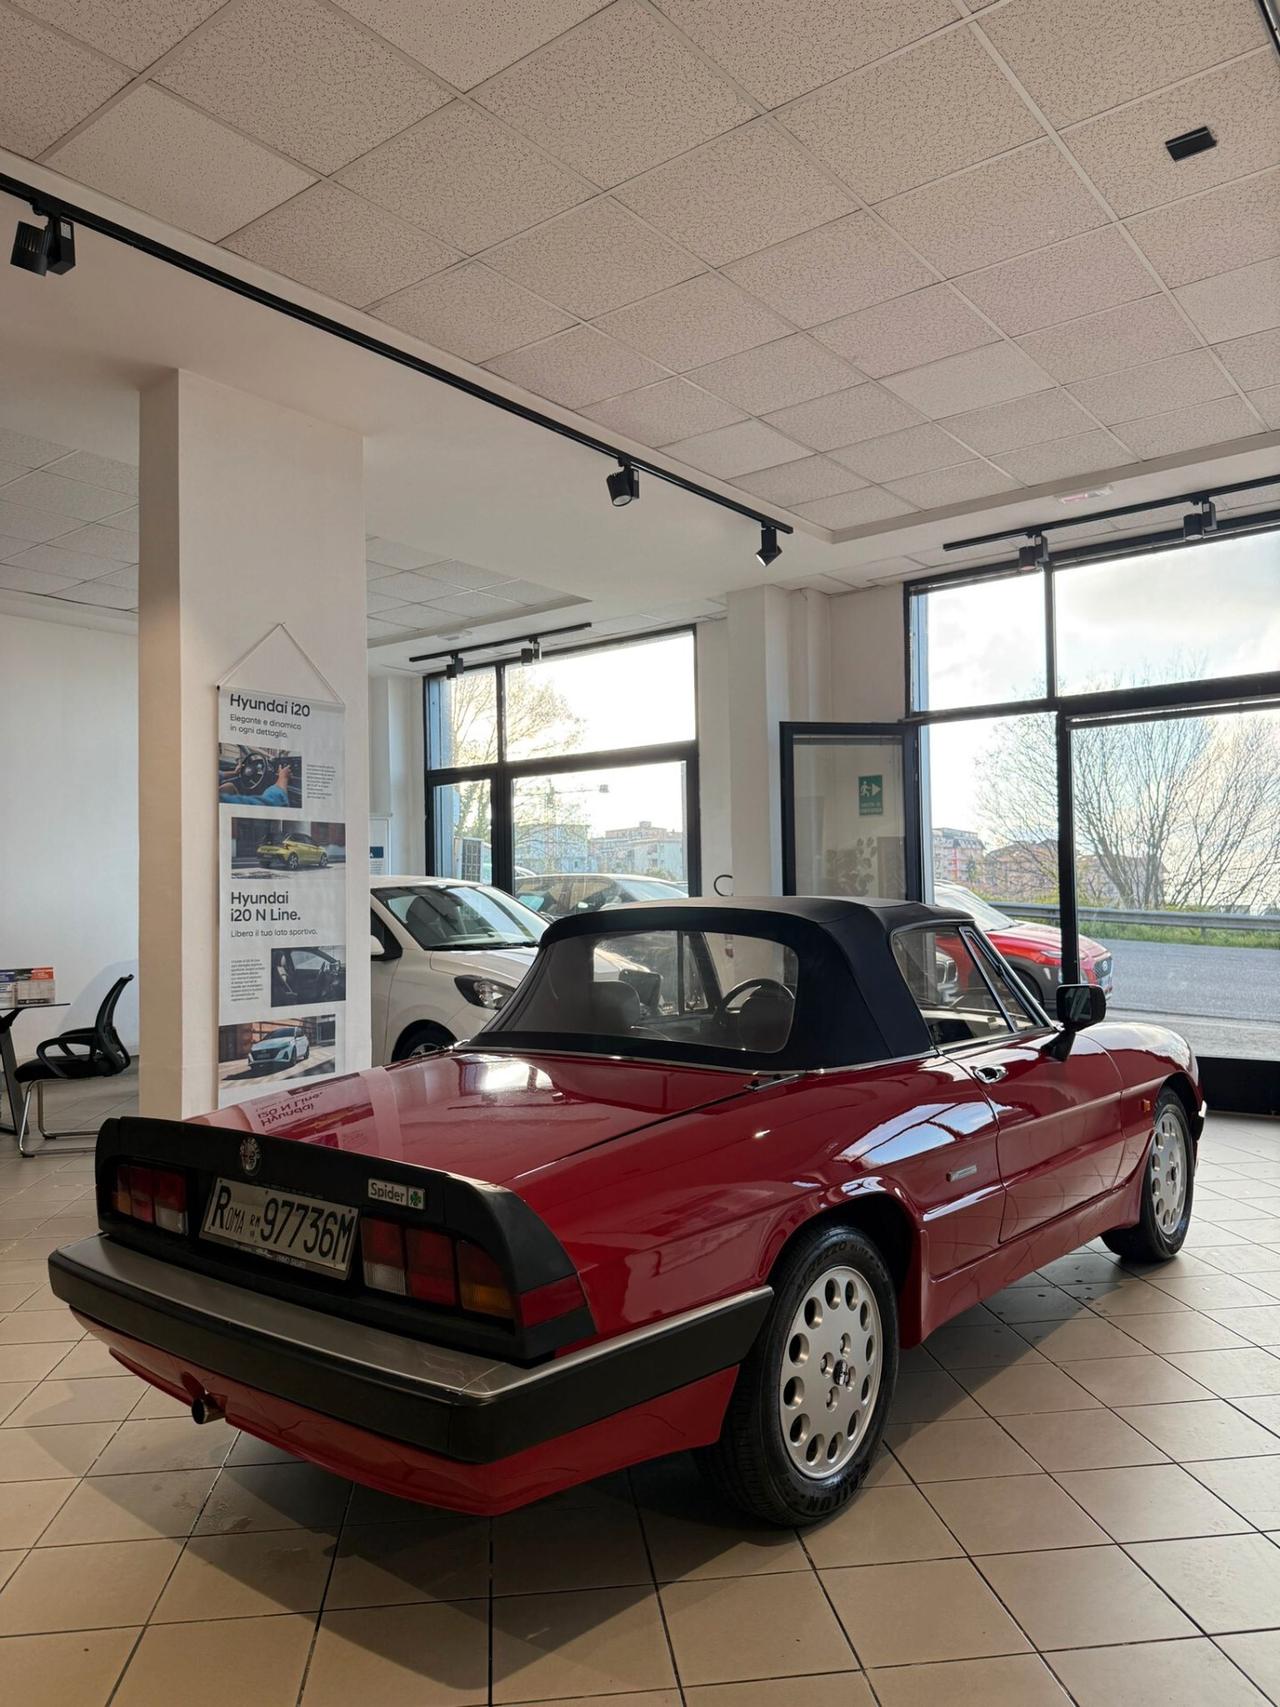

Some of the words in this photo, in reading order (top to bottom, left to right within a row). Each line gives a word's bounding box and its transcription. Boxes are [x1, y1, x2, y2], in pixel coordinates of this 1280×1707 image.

[230, 694, 288, 715] Hyundai
[291, 702, 311, 717] i20
[230, 714, 261, 725] Elegante
[269, 719, 302, 730] dinamico
[238, 727, 254, 735] ogni
[256, 728, 288, 739] dettaglio.
[231, 891, 289, 907] Hyundai
[231, 908, 252, 923] i20
[255, 908, 267, 922] N
[270, 908, 301, 922] Line.
[231, 929, 254, 938] Libera
[255, 929, 260, 937] il
[261, 929, 273, 937] tuo
[274, 928, 288, 937] lato
[289, 928, 318, 938] sportivo.
[370, 1183, 406, 1203] Spider
[260, 1197, 355, 1264] 97736M
